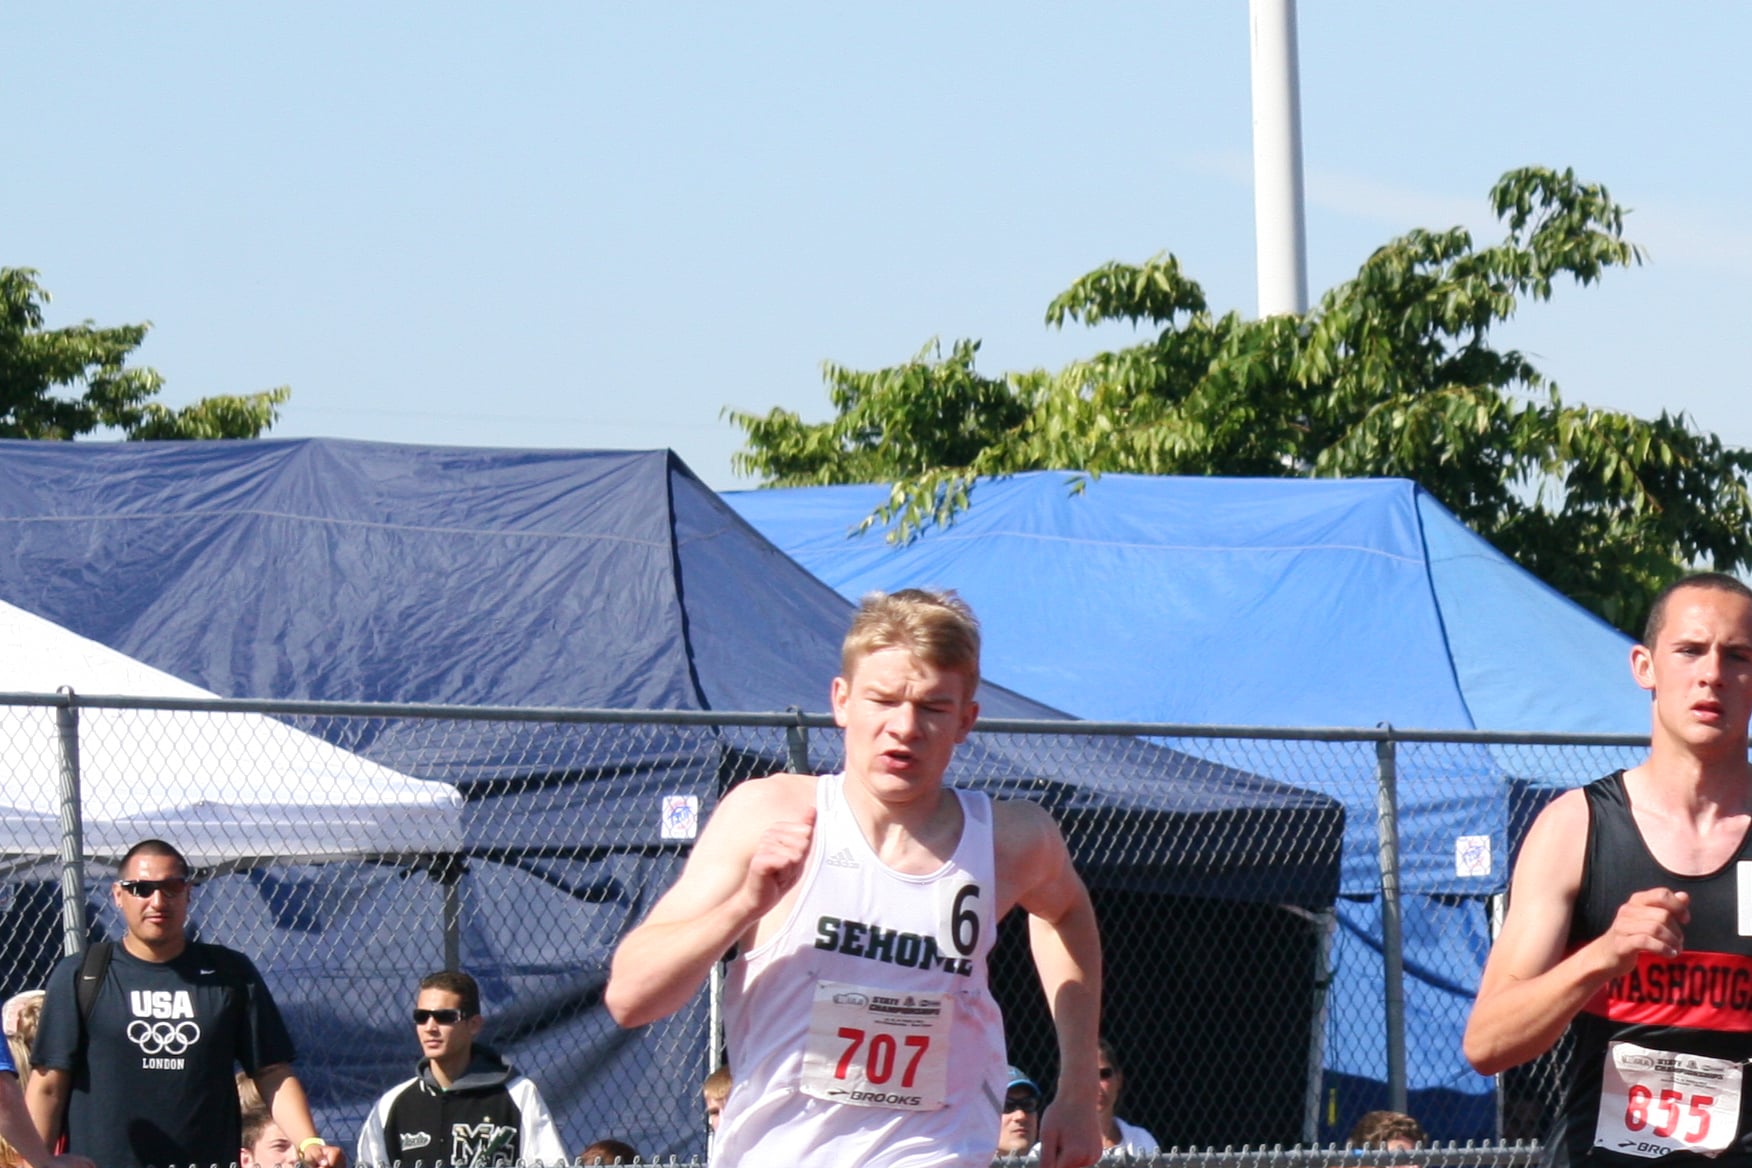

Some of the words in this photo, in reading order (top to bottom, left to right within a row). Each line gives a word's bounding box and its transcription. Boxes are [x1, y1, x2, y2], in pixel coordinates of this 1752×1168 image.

[952, 884, 981, 956] 6
[131, 990, 195, 1019] USA
[142, 1057, 185, 1070] LONDON
[834, 1027, 930, 1088] 707
[850, 1091, 922, 1106] BROOKS
[1624, 1084, 1714, 1144] 855
